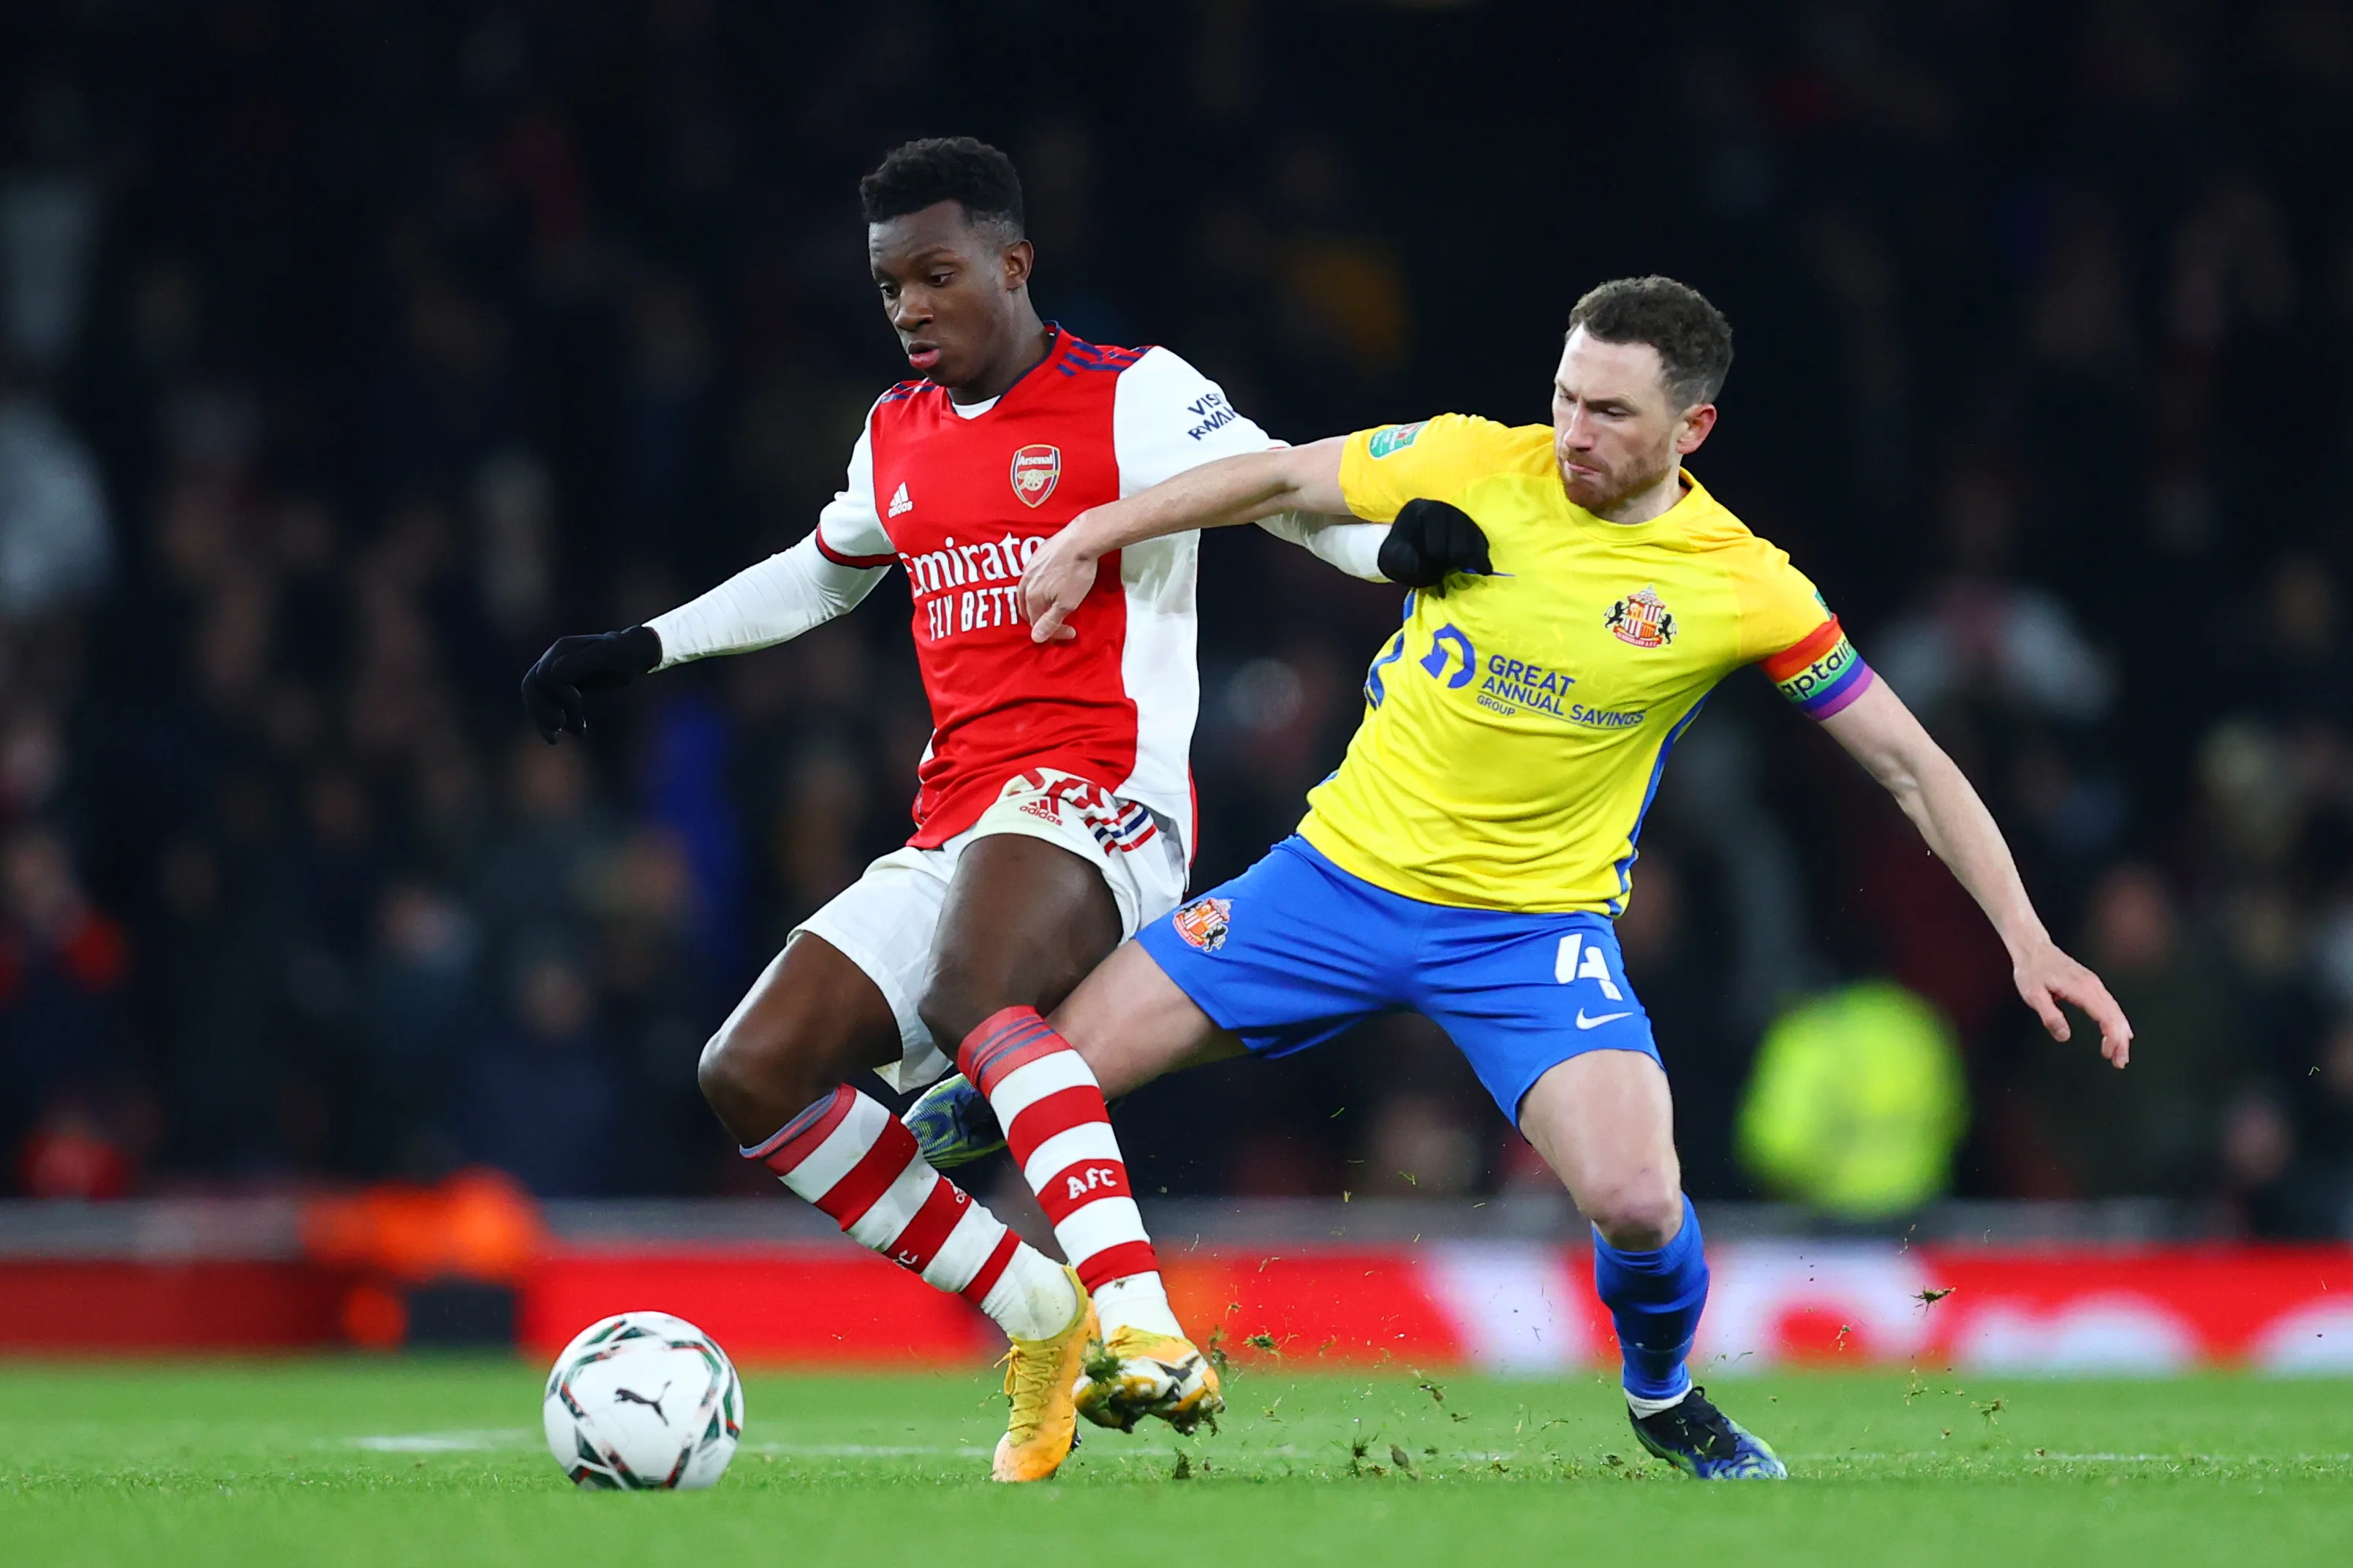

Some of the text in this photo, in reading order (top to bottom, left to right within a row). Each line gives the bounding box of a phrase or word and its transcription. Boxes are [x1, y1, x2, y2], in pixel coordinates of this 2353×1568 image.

[1018, 453, 1053, 466] Arsenal
[888, 501, 913, 518] adidas
[926, 585, 1019, 643] FLY BETT
[1488, 654, 1575, 697] GREAT
[1477, 694, 1516, 716] GROUP
[1481, 677, 1645, 727] ANNUAL SAVINGS
[1019, 805, 1064, 826] adidas
[1555, 933, 1623, 1001] 4
[1068, 1167, 1117, 1200] AFC
